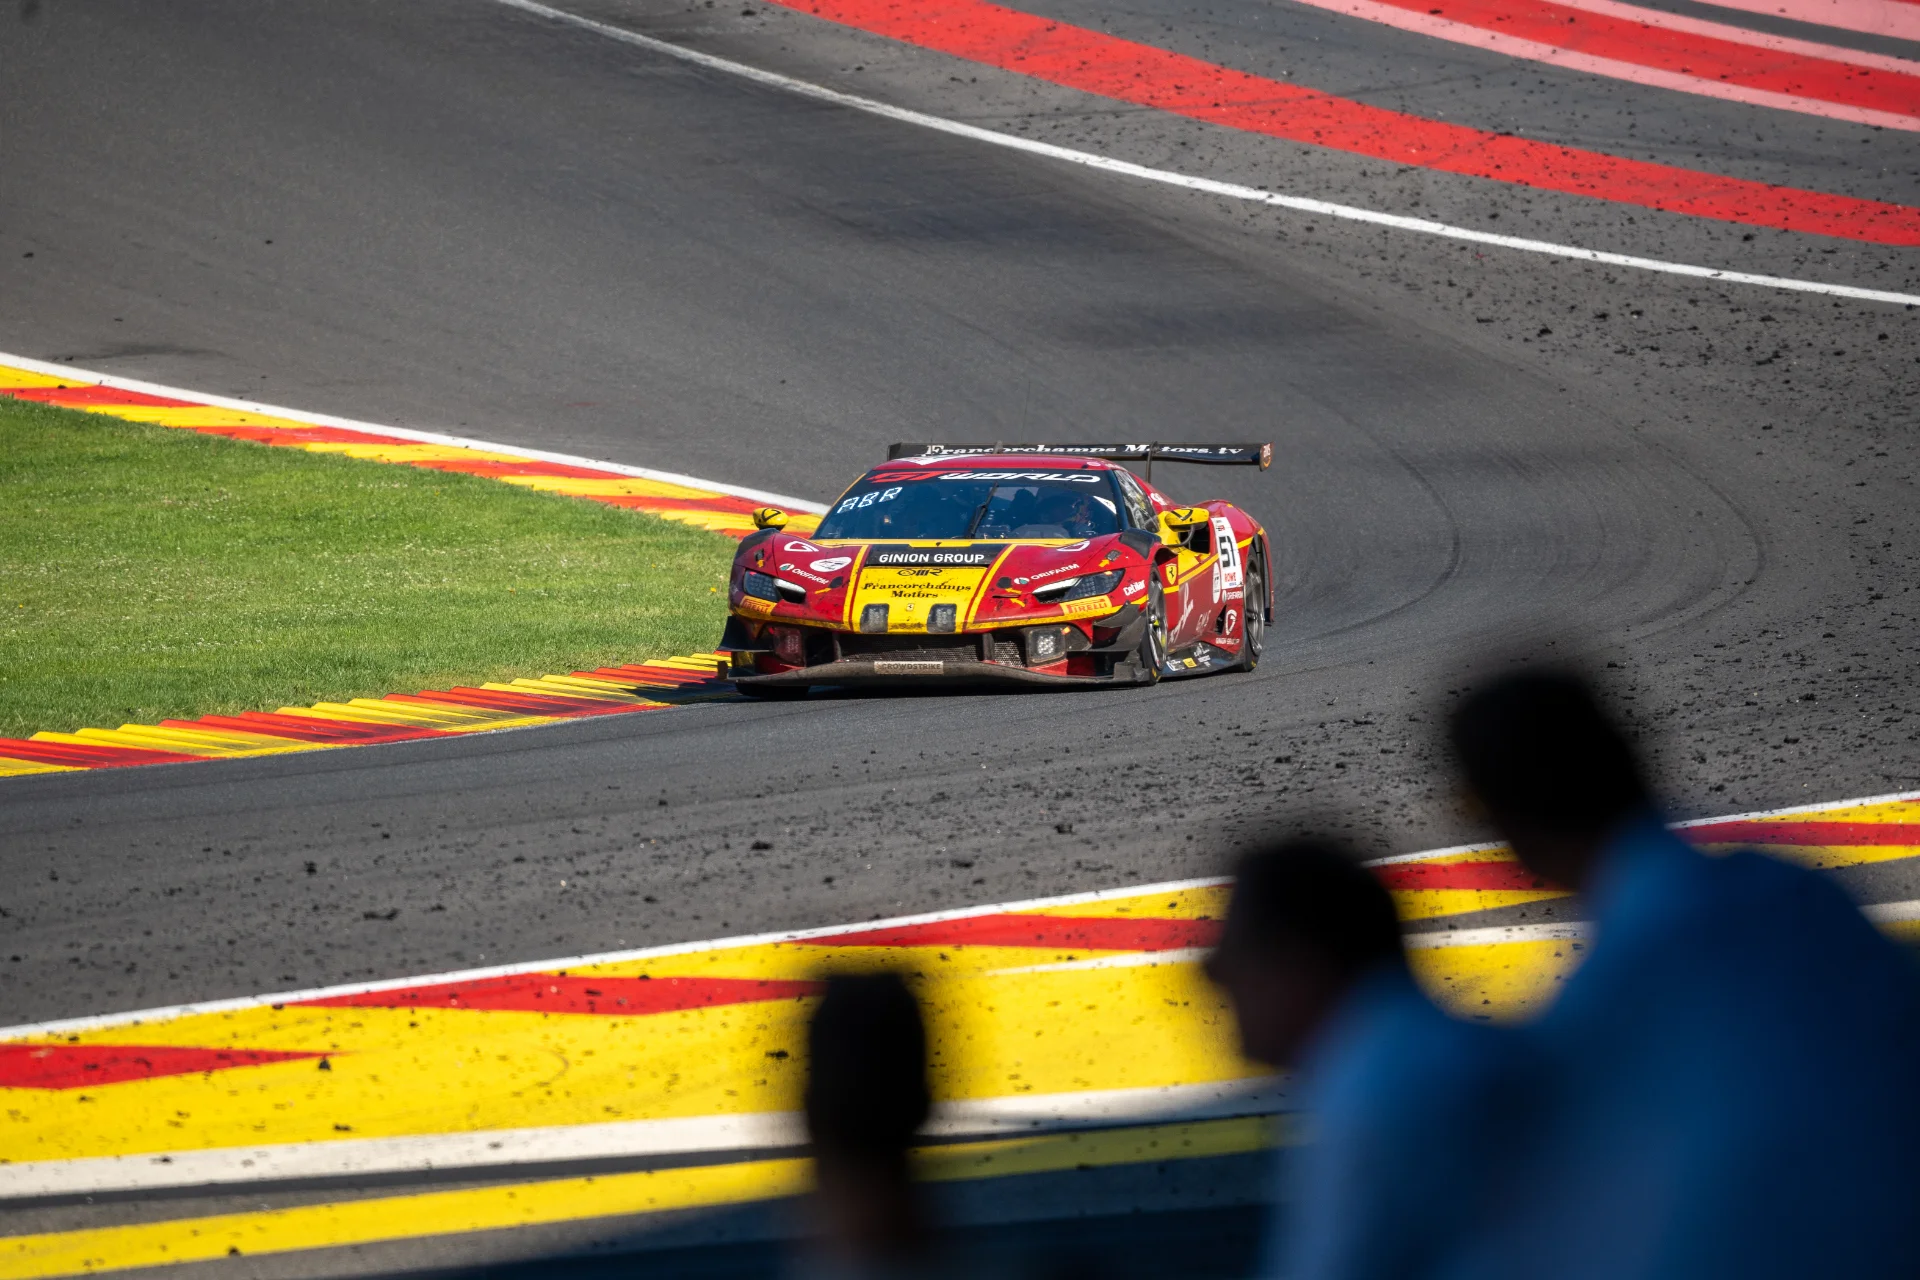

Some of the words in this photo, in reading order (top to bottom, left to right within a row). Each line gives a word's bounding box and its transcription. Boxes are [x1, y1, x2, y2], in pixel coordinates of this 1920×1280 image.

[1219, 535, 1236, 568] 51
[879, 553, 930, 563] GINION
[933, 553, 985, 564] GROUP
[1030, 563, 1080, 580] ORIFARM
[862, 582, 971, 591] Francorchamps
[891, 591, 938, 599] Motors
[1066, 599, 1107, 614] PIRELLI
